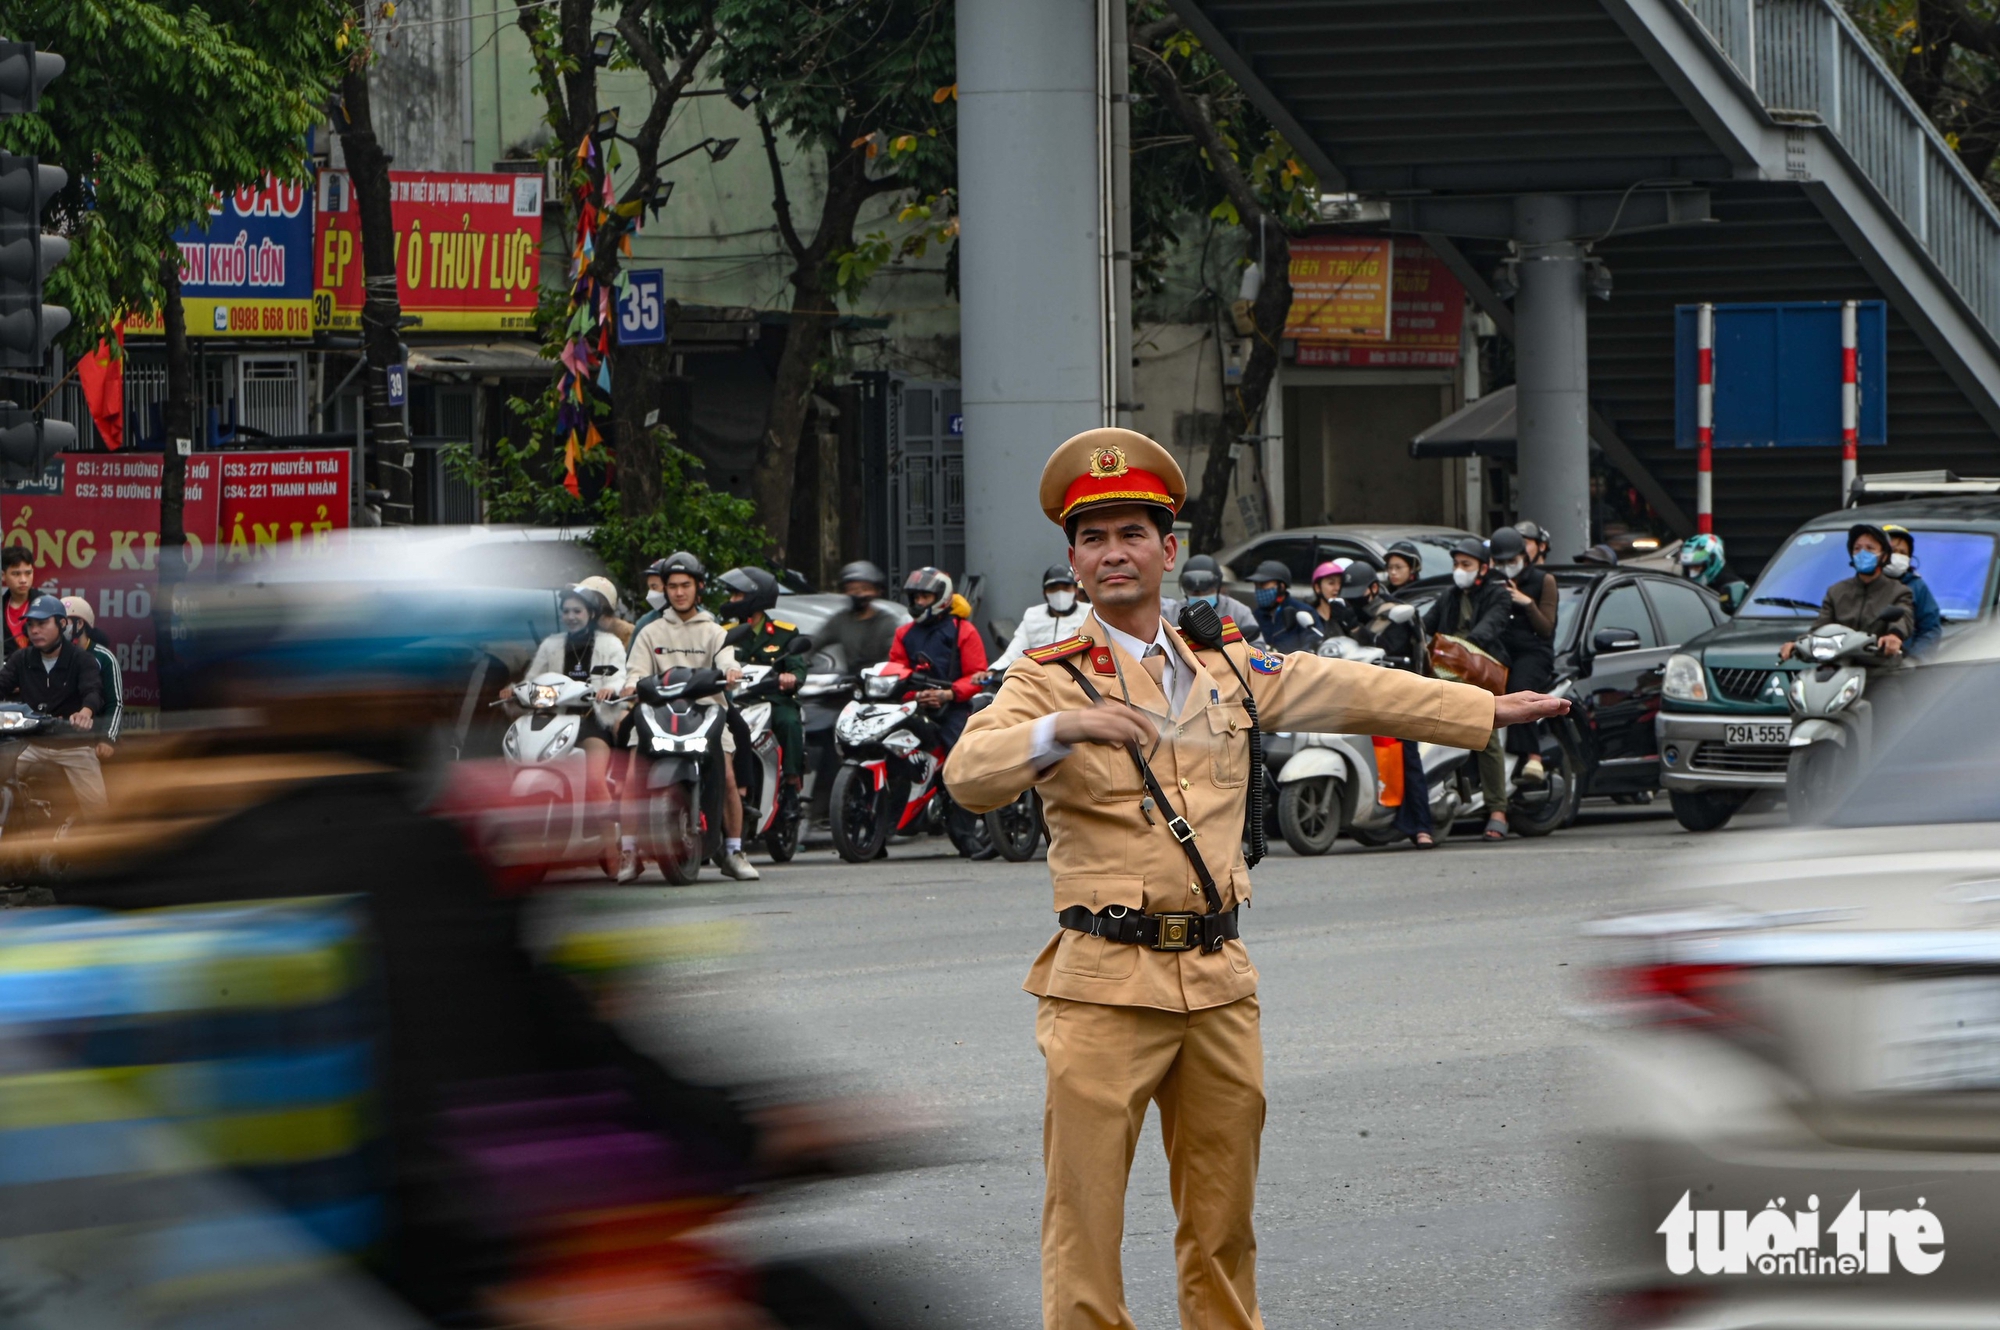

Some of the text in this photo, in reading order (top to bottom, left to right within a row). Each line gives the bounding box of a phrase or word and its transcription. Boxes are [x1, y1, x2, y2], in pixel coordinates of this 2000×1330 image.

[494, 184, 510, 204] NAM
[208, 230, 247, 286] KHỔ
[249, 237, 285, 286] LỚN
[322, 217, 352, 287] ÉP
[406, 219, 422, 289] Ô
[429, 213, 486, 289] THỦY
[490, 228, 533, 302] LỰC
[231, 306, 308, 331] 0988 668 016
[314, 295, 331, 326] 39
[622, 283, 659, 331] 35
[391, 372, 403, 397] 39
[76, 462, 99, 476] CS1:
[102, 463, 121, 477] 215
[123, 461, 158, 478] ĐƯỜNG
[224, 457, 339, 477] CS3: 277 NGUYỄN TRÃI
[75, 484, 98, 497] CS2:
[101, 485, 114, 498] 35
[116, 482, 151, 499] ĐƯỜNG
[224, 480, 337, 498] CS4: 221 THANH NHÀN
[1, 505, 97, 569] ỔNG
[654, 647, 706, 657] Champion
